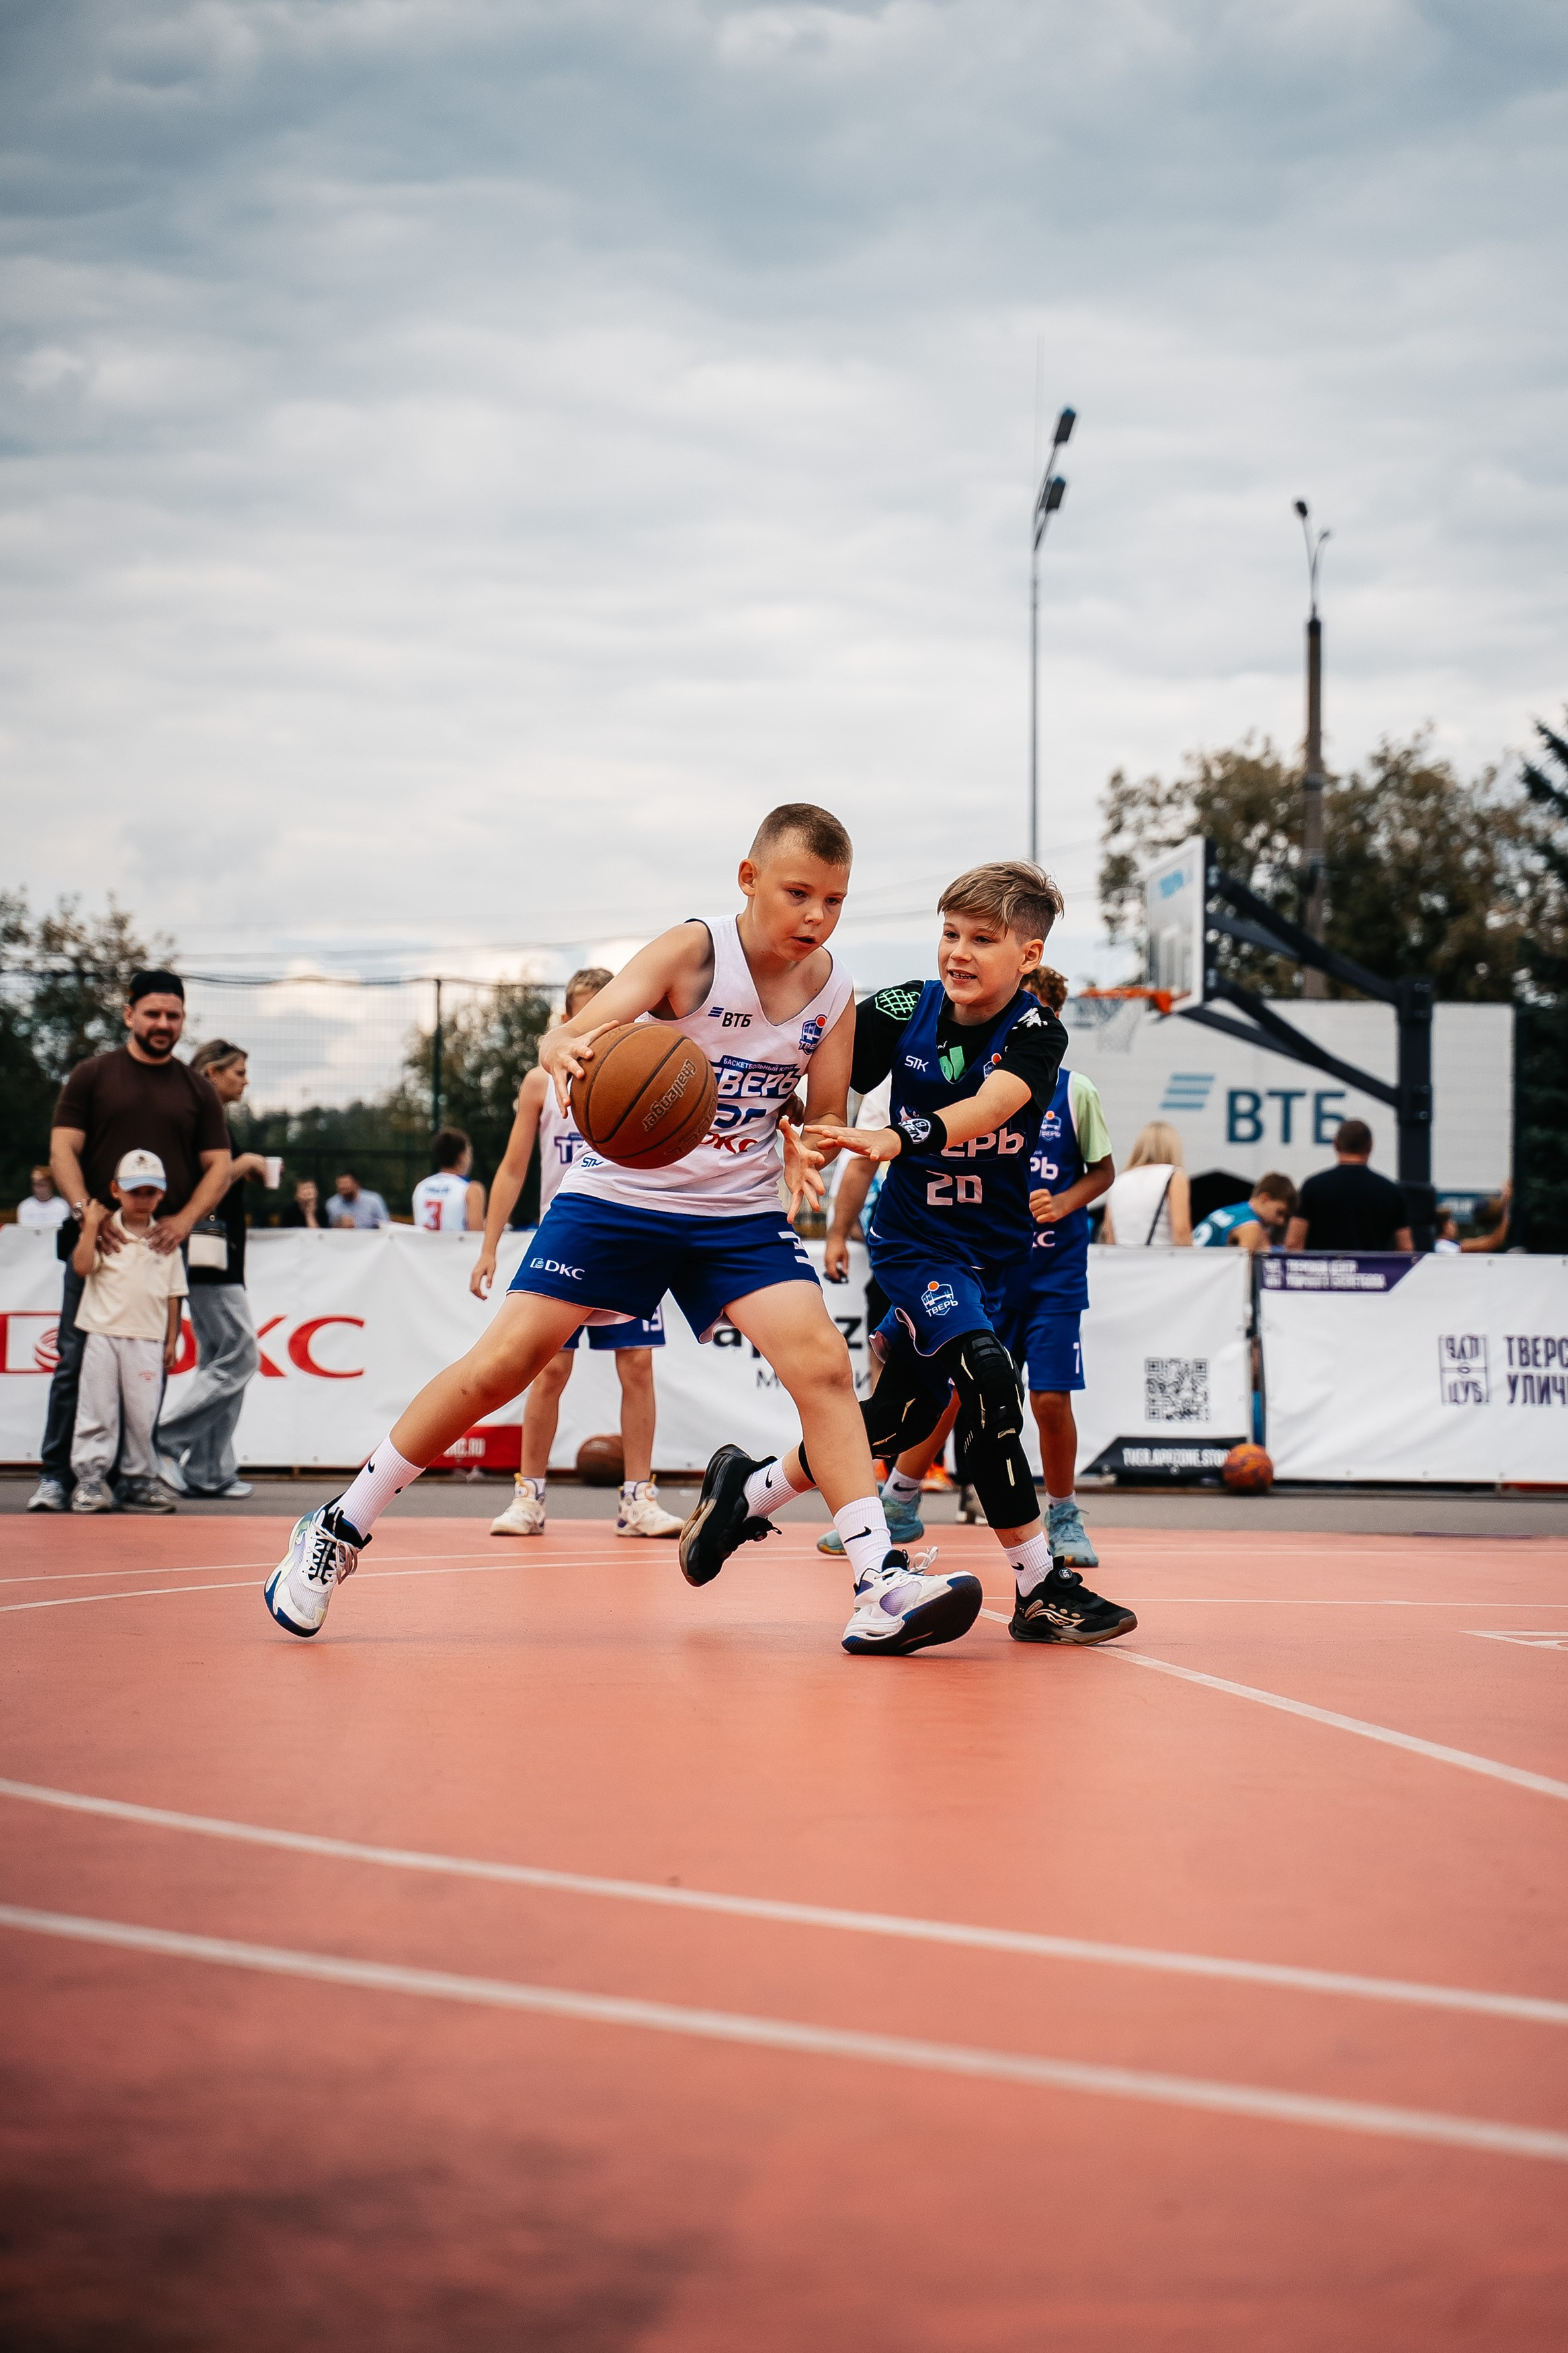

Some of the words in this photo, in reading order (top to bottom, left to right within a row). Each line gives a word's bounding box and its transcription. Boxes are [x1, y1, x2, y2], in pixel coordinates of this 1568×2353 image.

[722, 1012, 753, 1028] ВТБ
[798, 1041, 817, 1051] ТВЕ
[723, 1058, 778, 1072] БАСКЕТБОЛЬНЫЙ
[904, 1055, 930, 1072] STK
[642, 1058, 697, 1132] Challenger
[712, 1066, 799, 1097] ВЕРЬ
[1227, 1090, 1347, 1144] ВТБ
[925, 1169, 983, 1205] 20
[425, 1201, 442, 1230] 3
[544, 1259, 585, 1280] DKC
[925, 1299, 958, 1317] ТВЕРЬ
[1506, 1335, 1568, 1367] ТВЕРС
[1506, 1375, 1568, 1405] УЛИЧ
